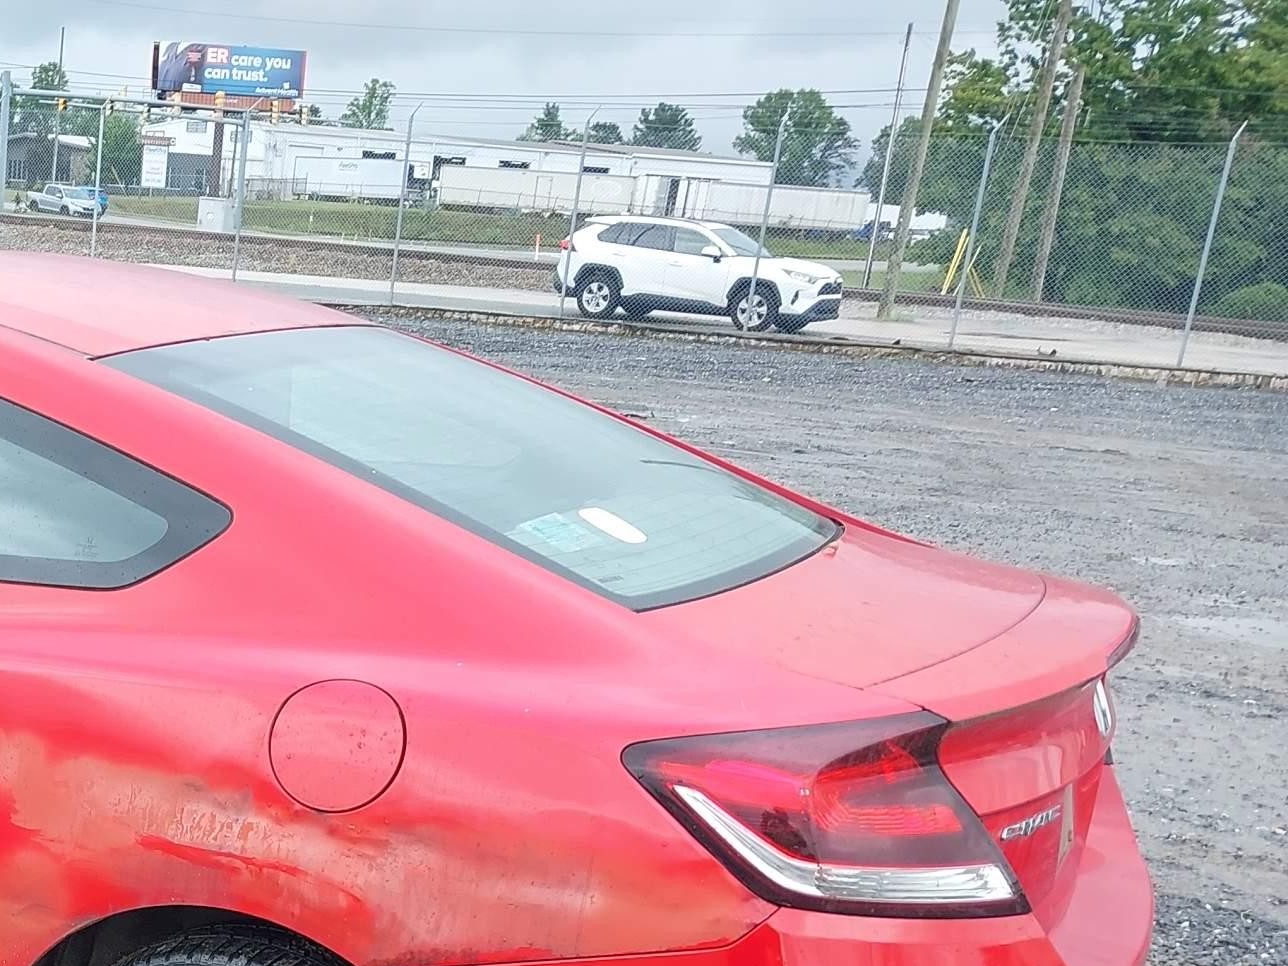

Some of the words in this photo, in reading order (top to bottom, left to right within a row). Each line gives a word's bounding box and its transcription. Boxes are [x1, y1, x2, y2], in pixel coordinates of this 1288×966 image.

[206, 47, 229, 63] ER
[231, 55, 263, 67] care
[265, 57, 292, 70] you
[204, 68, 230, 79] can
[232, 68, 268, 81] trust.
[1001, 804, 1062, 841] CIVIC
